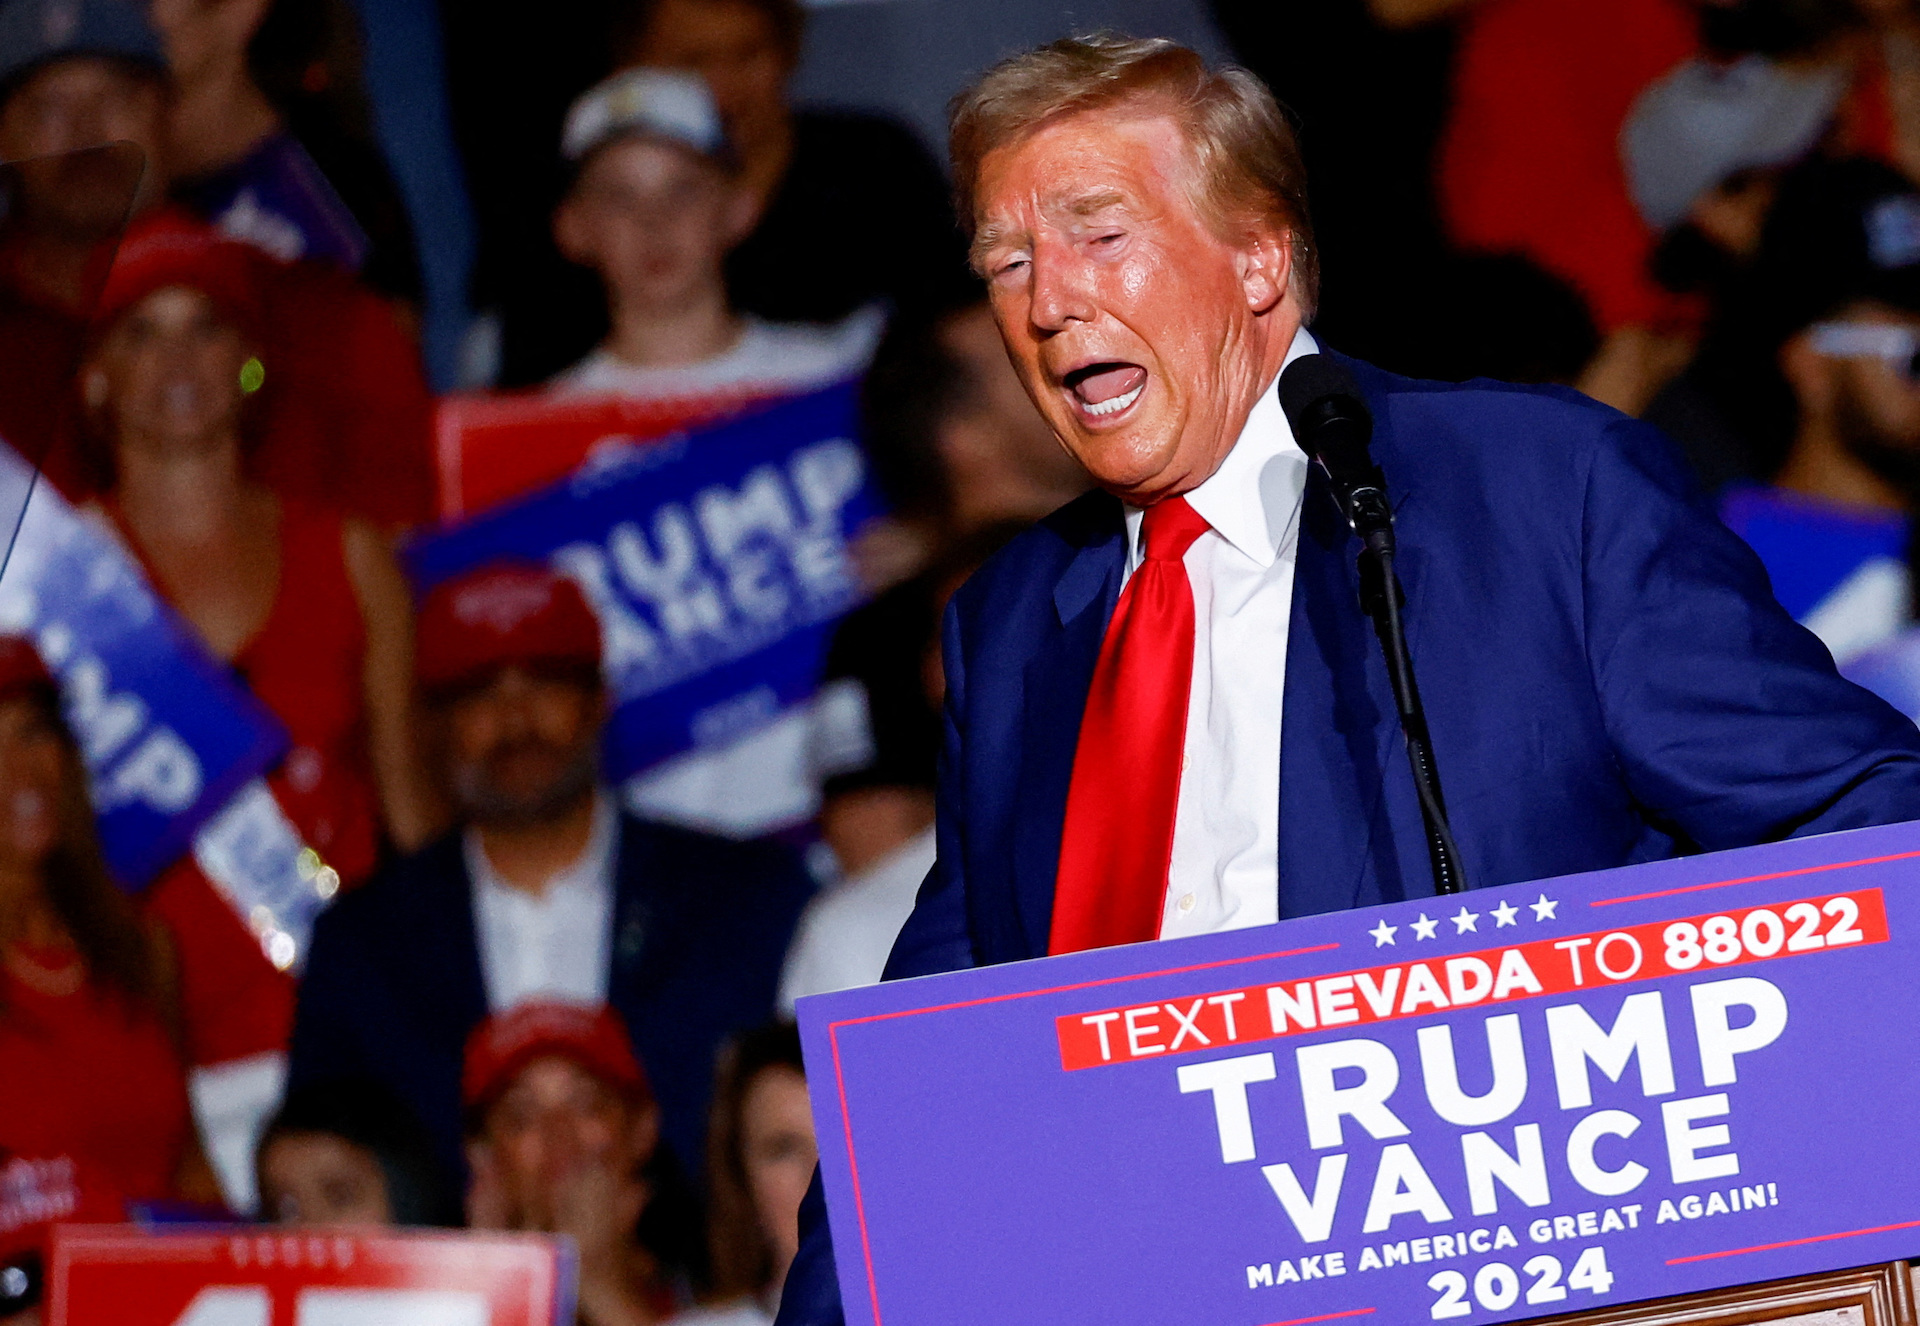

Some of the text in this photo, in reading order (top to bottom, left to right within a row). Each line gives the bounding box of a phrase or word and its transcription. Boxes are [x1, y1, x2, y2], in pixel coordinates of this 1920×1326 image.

[1081, 896, 1864, 1061] TEXT NEVADA TO 88022
[1176, 977, 1788, 1164] TRUMP
[1246, 1182, 1779, 1289] MAKE AMERICA GREAT AGAIN!
[1261, 1092, 1740, 1244] VANCE
[1427, 1246, 1614, 1320] 2024
